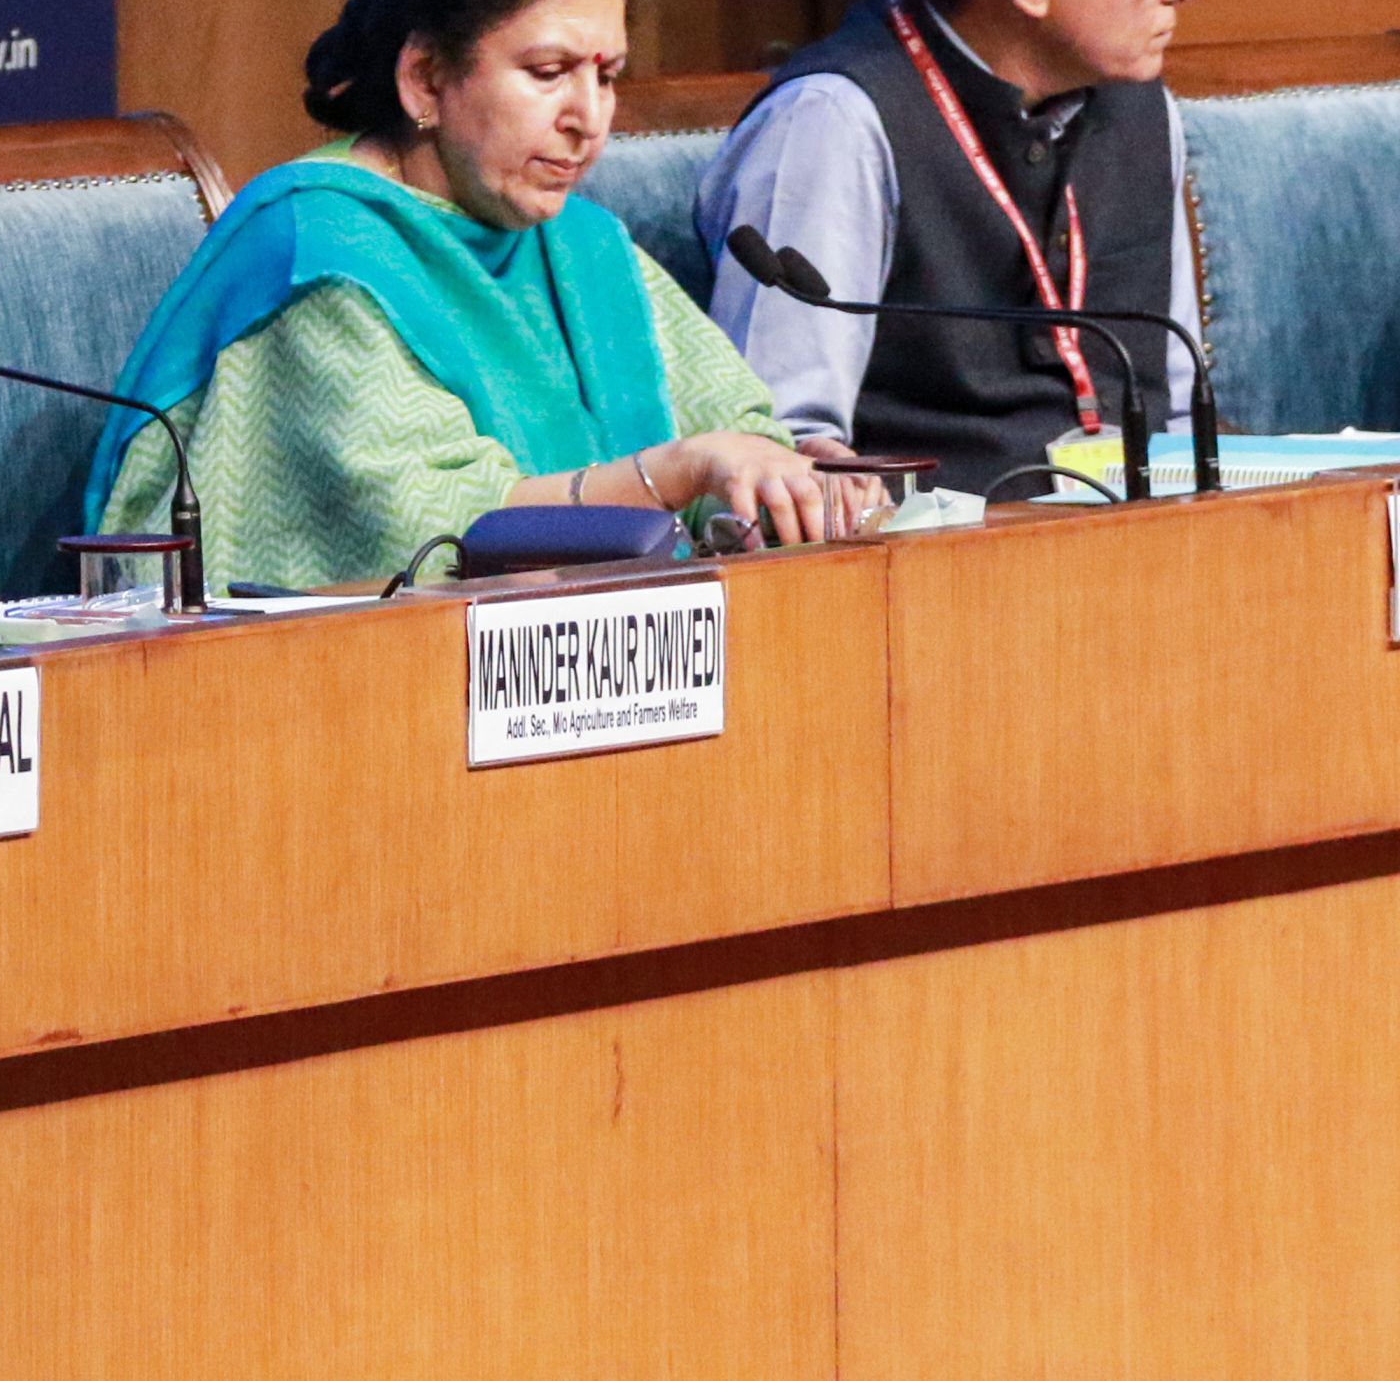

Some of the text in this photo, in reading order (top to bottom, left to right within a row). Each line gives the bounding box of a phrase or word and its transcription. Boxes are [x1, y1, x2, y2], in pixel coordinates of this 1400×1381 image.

[478, 605, 721, 712] MANINDER KAUR DWIVEDI
[506, 716, 528, 739] Addl.
[553, 711, 567, 735] M/o
[570, 708, 614, 738] Agriculture
[616, 705, 631, 727] and
[634, 702, 666, 725] Farmers
[668, 697, 697, 720] Welfare
